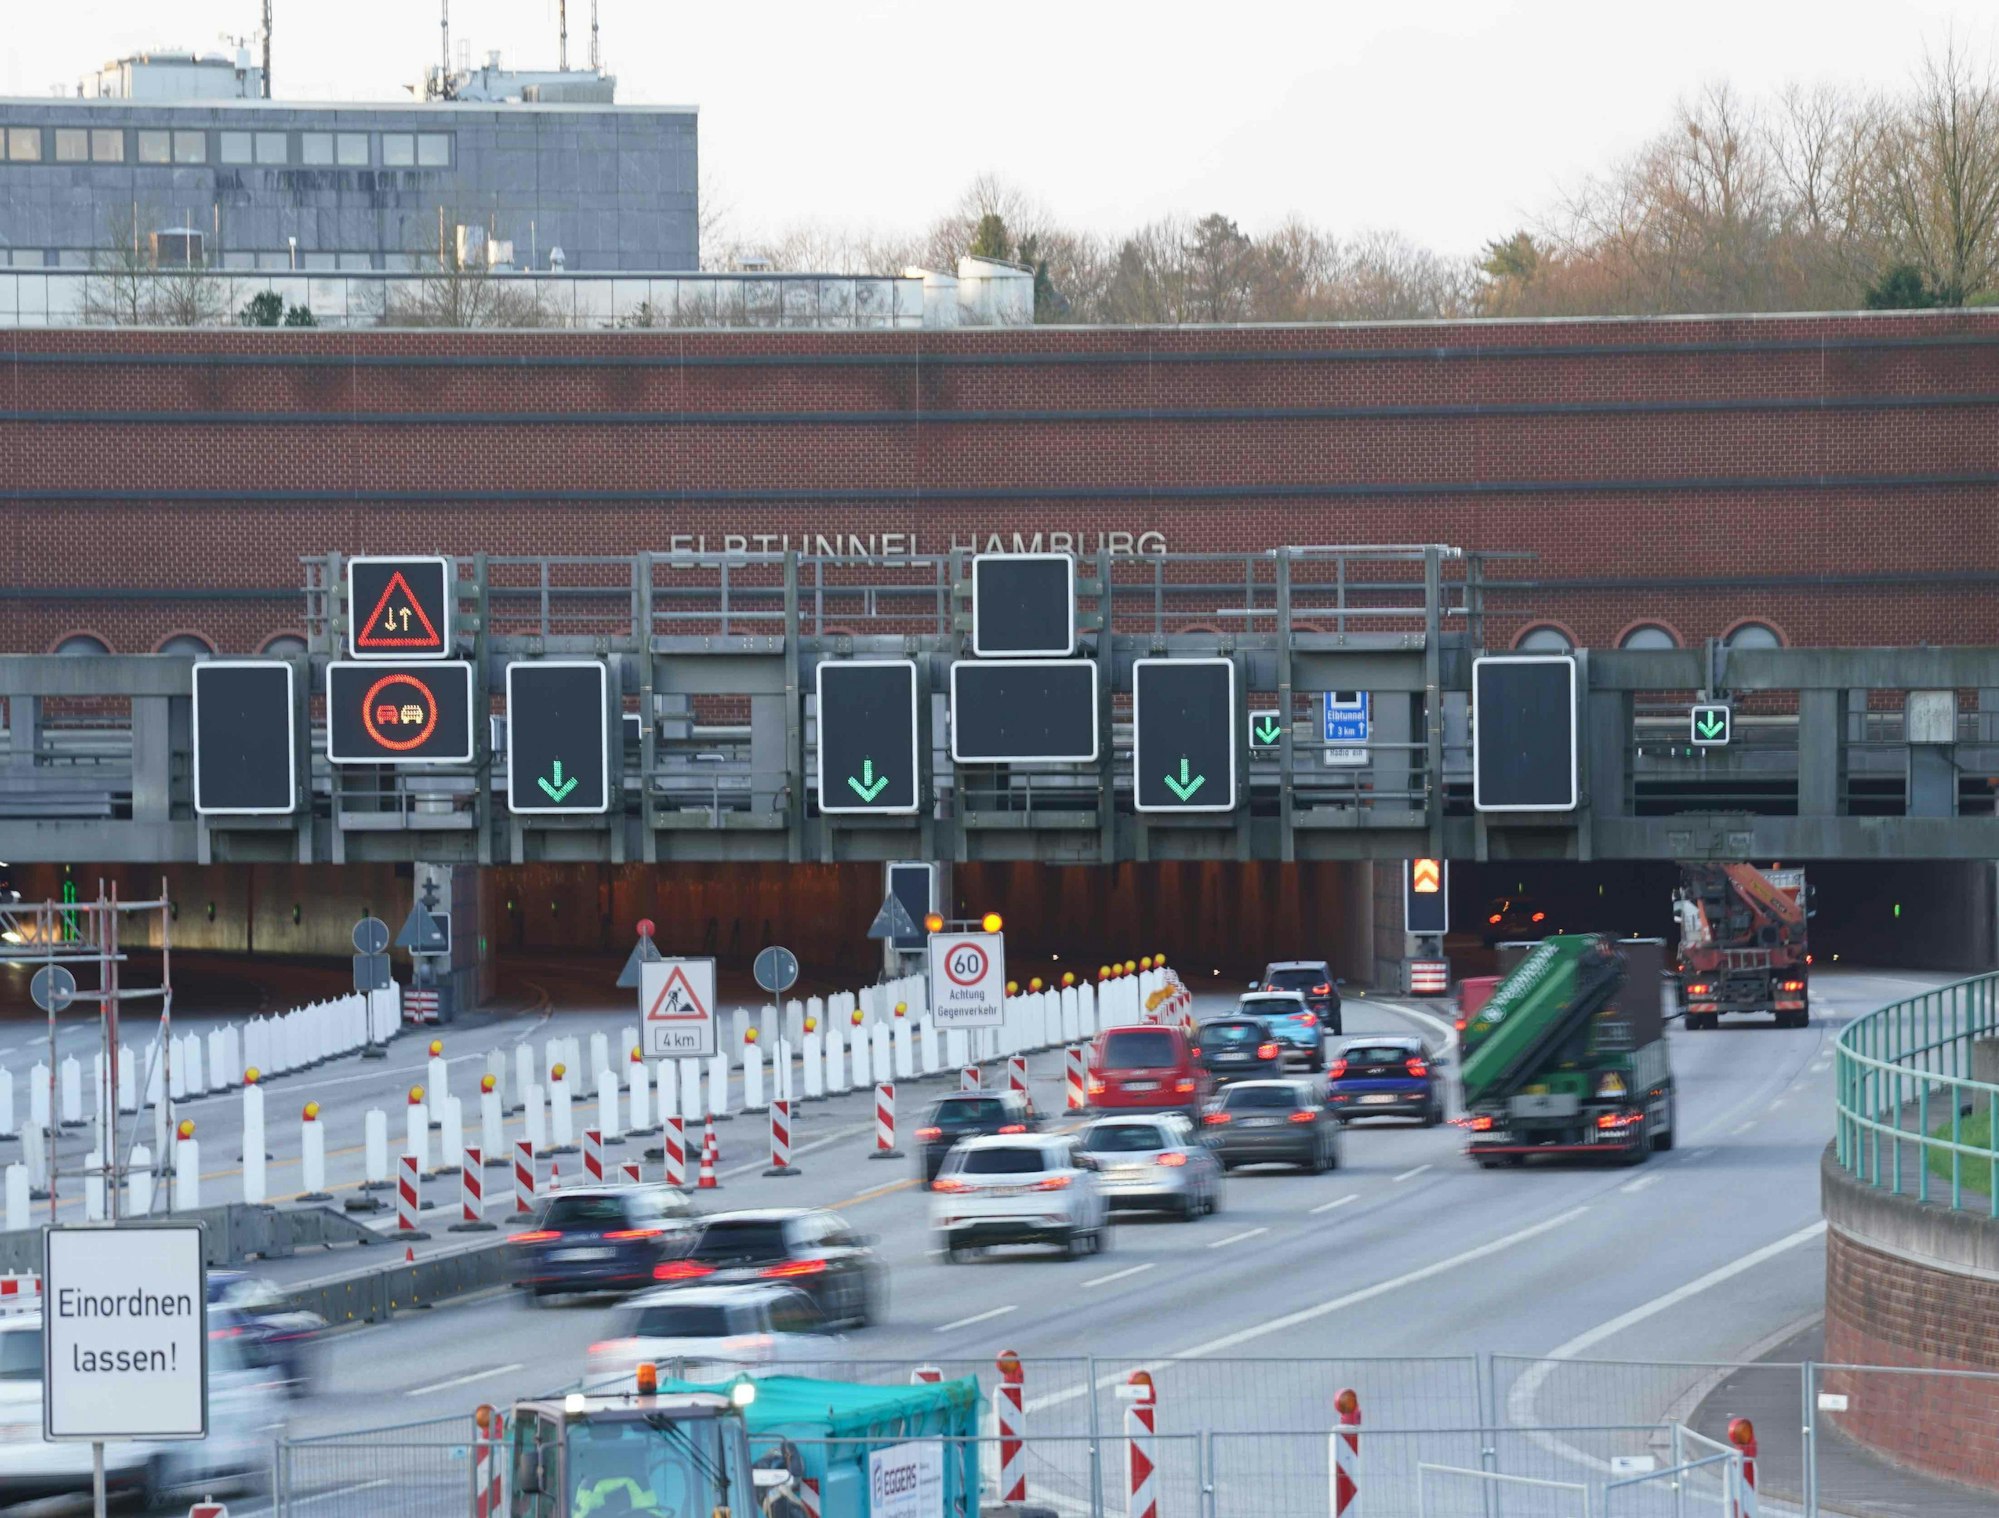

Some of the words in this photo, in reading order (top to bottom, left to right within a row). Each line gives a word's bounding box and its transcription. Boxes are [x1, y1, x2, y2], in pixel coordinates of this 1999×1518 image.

[671, 533, 932, 568] ELBTUNNEL
[951, 531, 1167, 564] HAMBURG
[1327, 709, 1366, 721] Elbtunnel
[1337, 726, 1343, 737] 3
[1344, 726, 1355, 736] km
[954, 954, 979, 975] 60
[949, 989, 985, 1002] Achtung
[937, 1004, 998, 1019] Gegenverkehr
[663, 1033, 671, 1047] 4
[674, 1032, 695, 1047] km
[58, 1287, 192, 1318] Einordnen
[73, 1341, 177, 1372] lassen!
[884, 1463, 917, 1496] EGGERS
